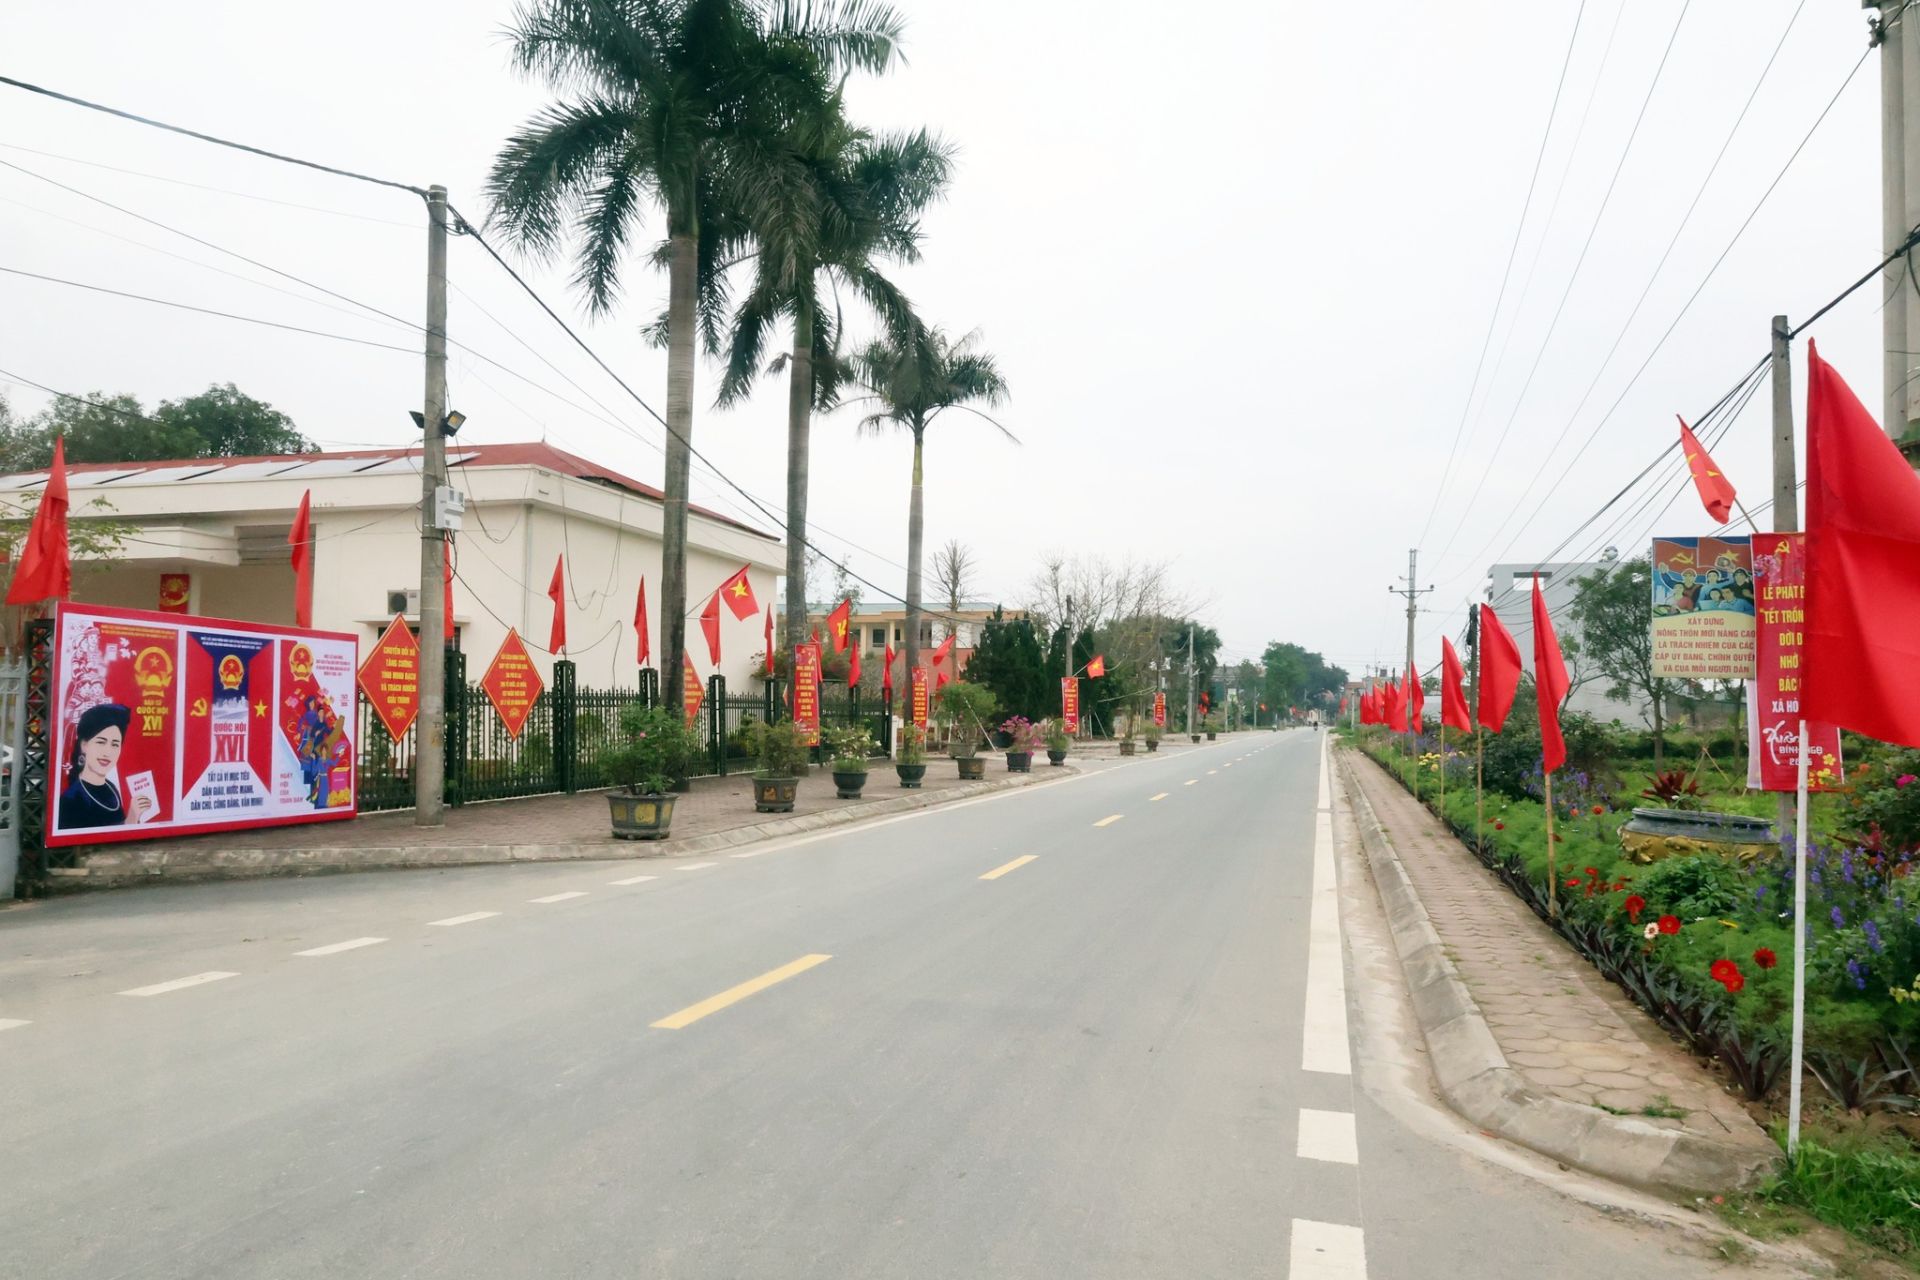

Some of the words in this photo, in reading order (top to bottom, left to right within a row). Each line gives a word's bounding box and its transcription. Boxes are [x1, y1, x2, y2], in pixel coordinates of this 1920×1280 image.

[1775, 583, 1799, 600] PHÁT
[1656, 628, 1678, 637] NÔNG
[1679, 629, 1699, 637] THÔN
[1778, 675, 1798, 692] BÁC
[213, 733, 246, 763] XVI
